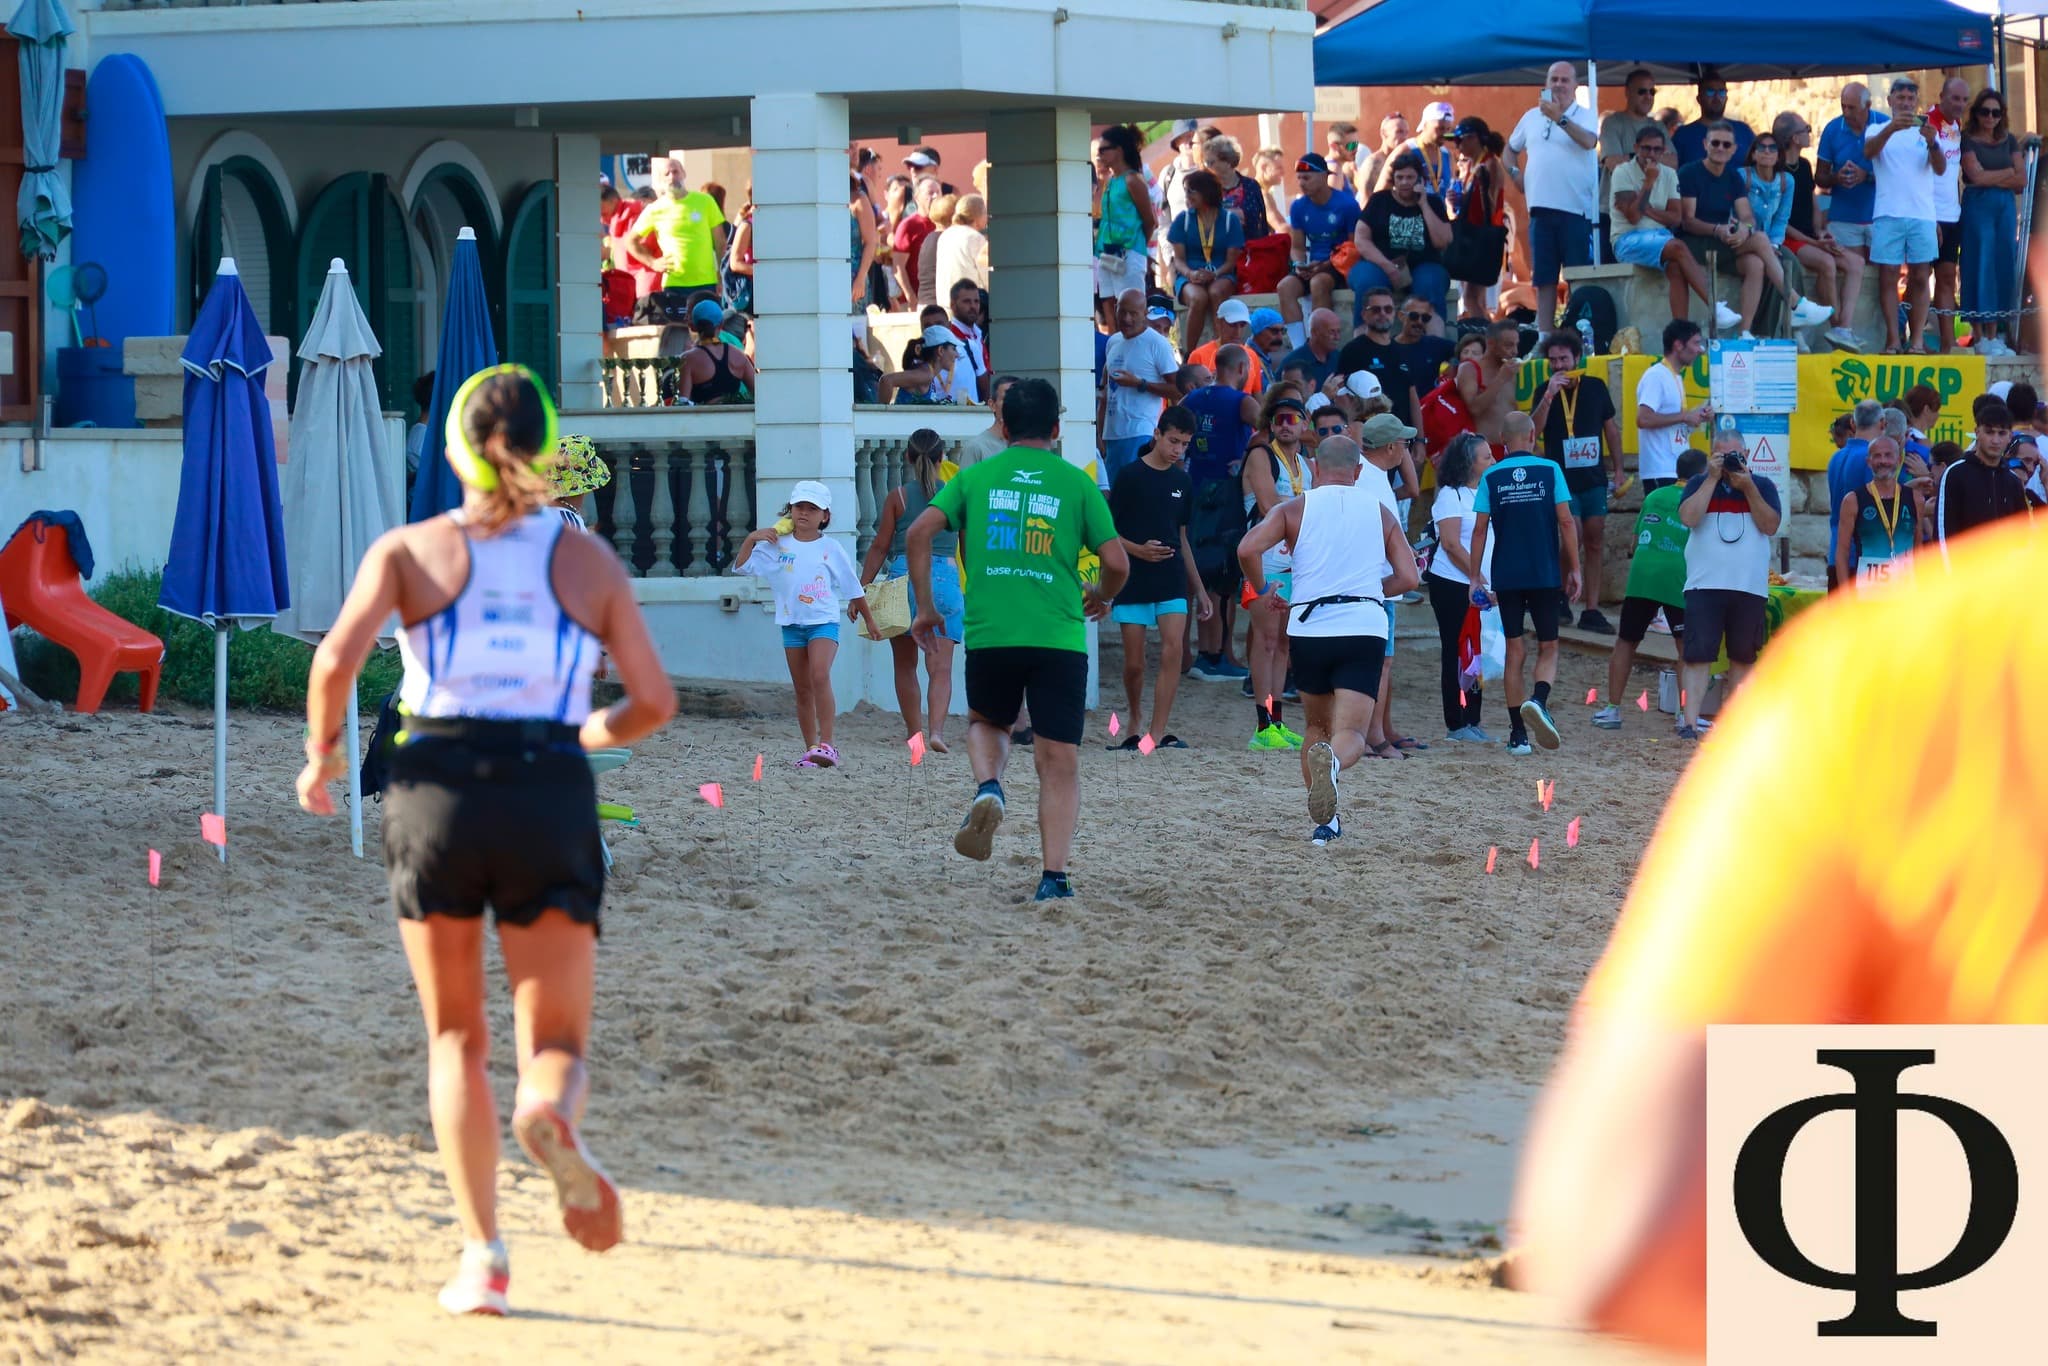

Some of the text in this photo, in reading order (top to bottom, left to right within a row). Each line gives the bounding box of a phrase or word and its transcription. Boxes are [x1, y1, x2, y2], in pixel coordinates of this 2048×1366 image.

[989, 489, 1021, 500] LA MEZZA DI
[1029, 493, 1037, 502] LA
[1053, 498, 1061, 507] DI
[989, 497, 1019, 512] TORINO
[1028, 501, 1059, 520] TORINO
[986, 525, 1018, 551] 21K
[1025, 530, 1055, 557] 10K
[986, 565, 1053, 584] base running
[1866, 563, 1890, 582] 115
